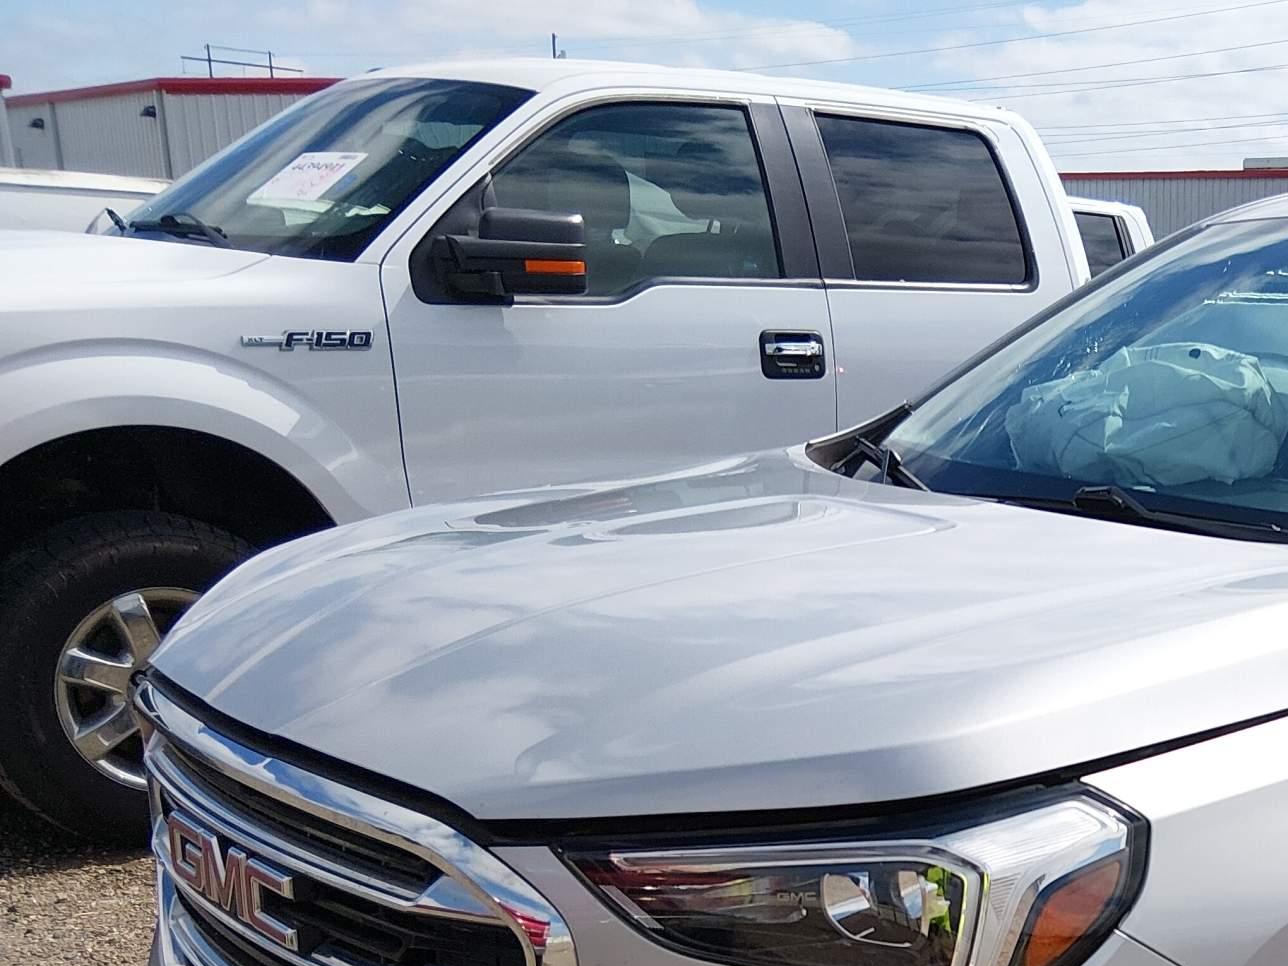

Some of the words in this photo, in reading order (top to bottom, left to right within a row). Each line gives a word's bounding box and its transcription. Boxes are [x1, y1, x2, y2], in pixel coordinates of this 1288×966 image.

[280, 329, 373, 351] F-150
[168, 811, 298, 951] GMC
[776, 891, 817, 901] GMC
